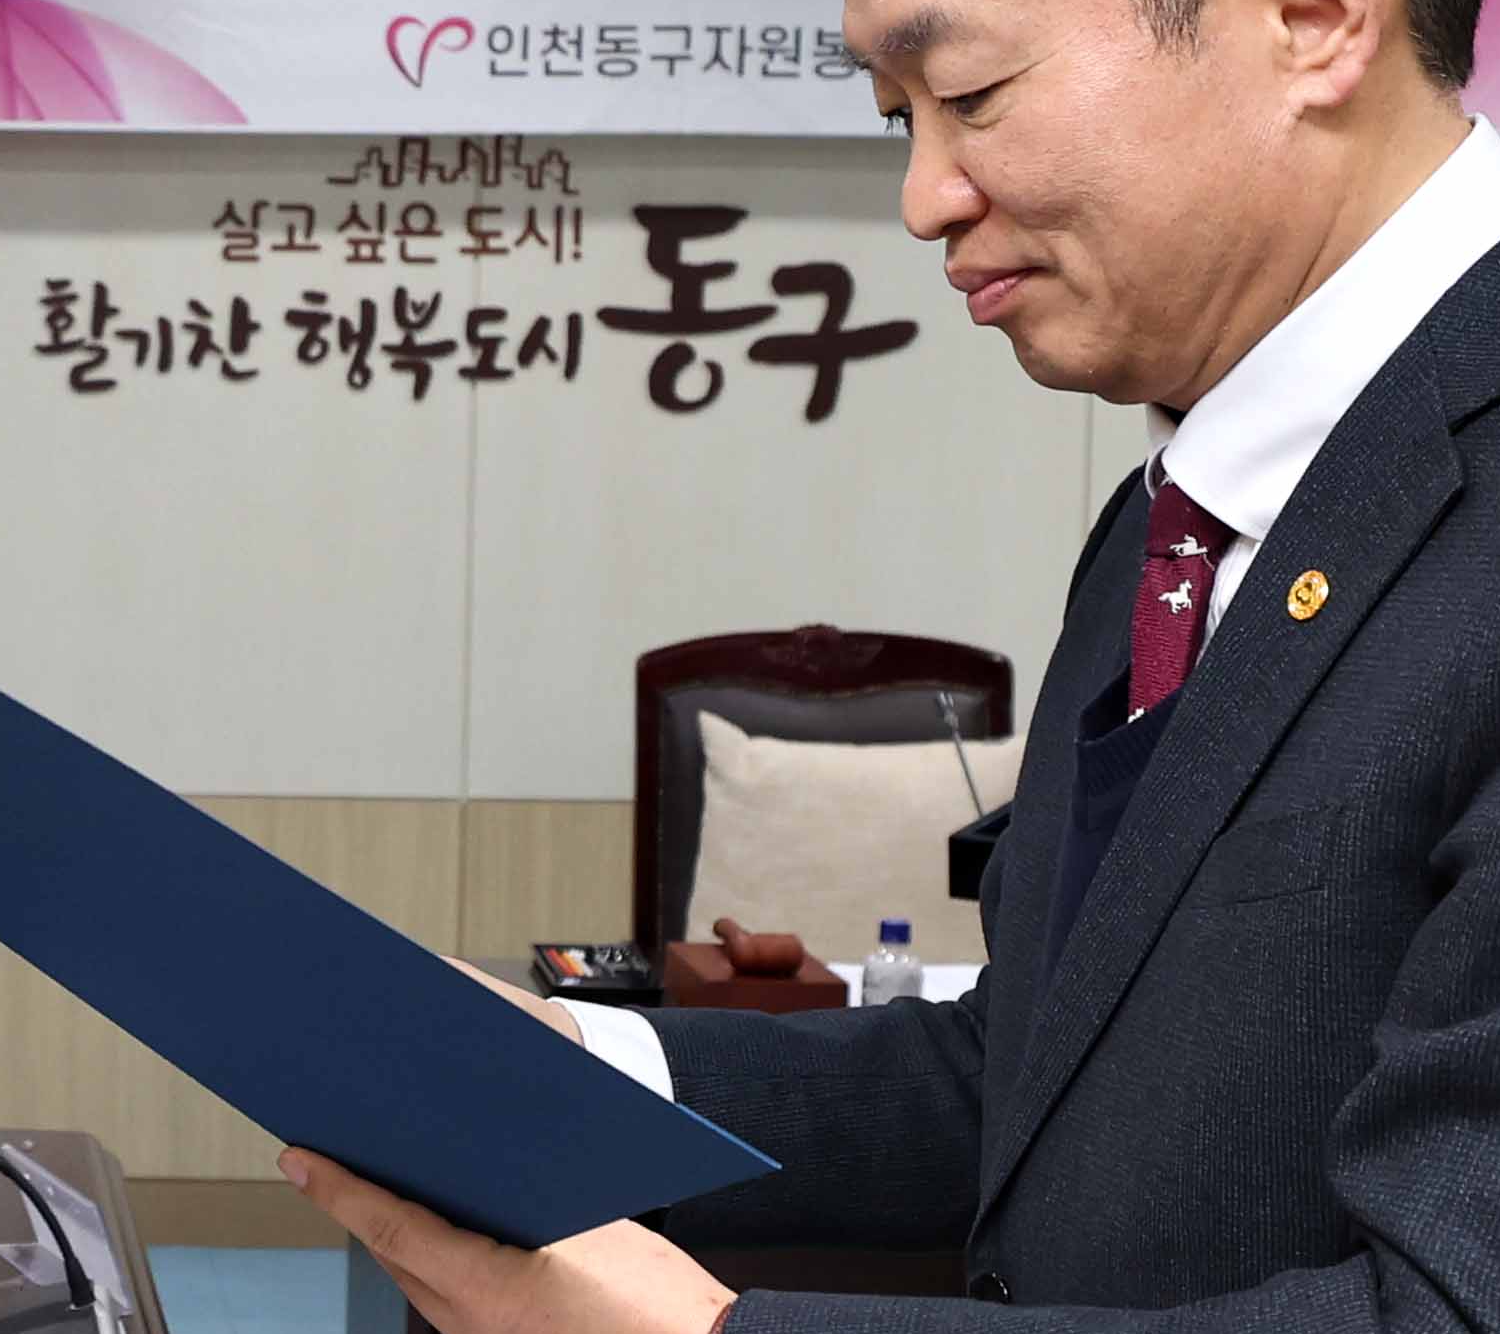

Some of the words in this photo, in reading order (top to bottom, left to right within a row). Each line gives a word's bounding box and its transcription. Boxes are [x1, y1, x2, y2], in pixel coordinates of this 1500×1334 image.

[486, 22, 858, 80] 인천동구자원봉
[212, 197, 322, 263] 살고
[336, 200, 442, 265] 싶은
[459, 204, 583, 263] 도시!
[35, 278, 263, 394] 활기찬
[284, 284, 584, 401] 행복도시
[600, 204, 919, 423] 동구
